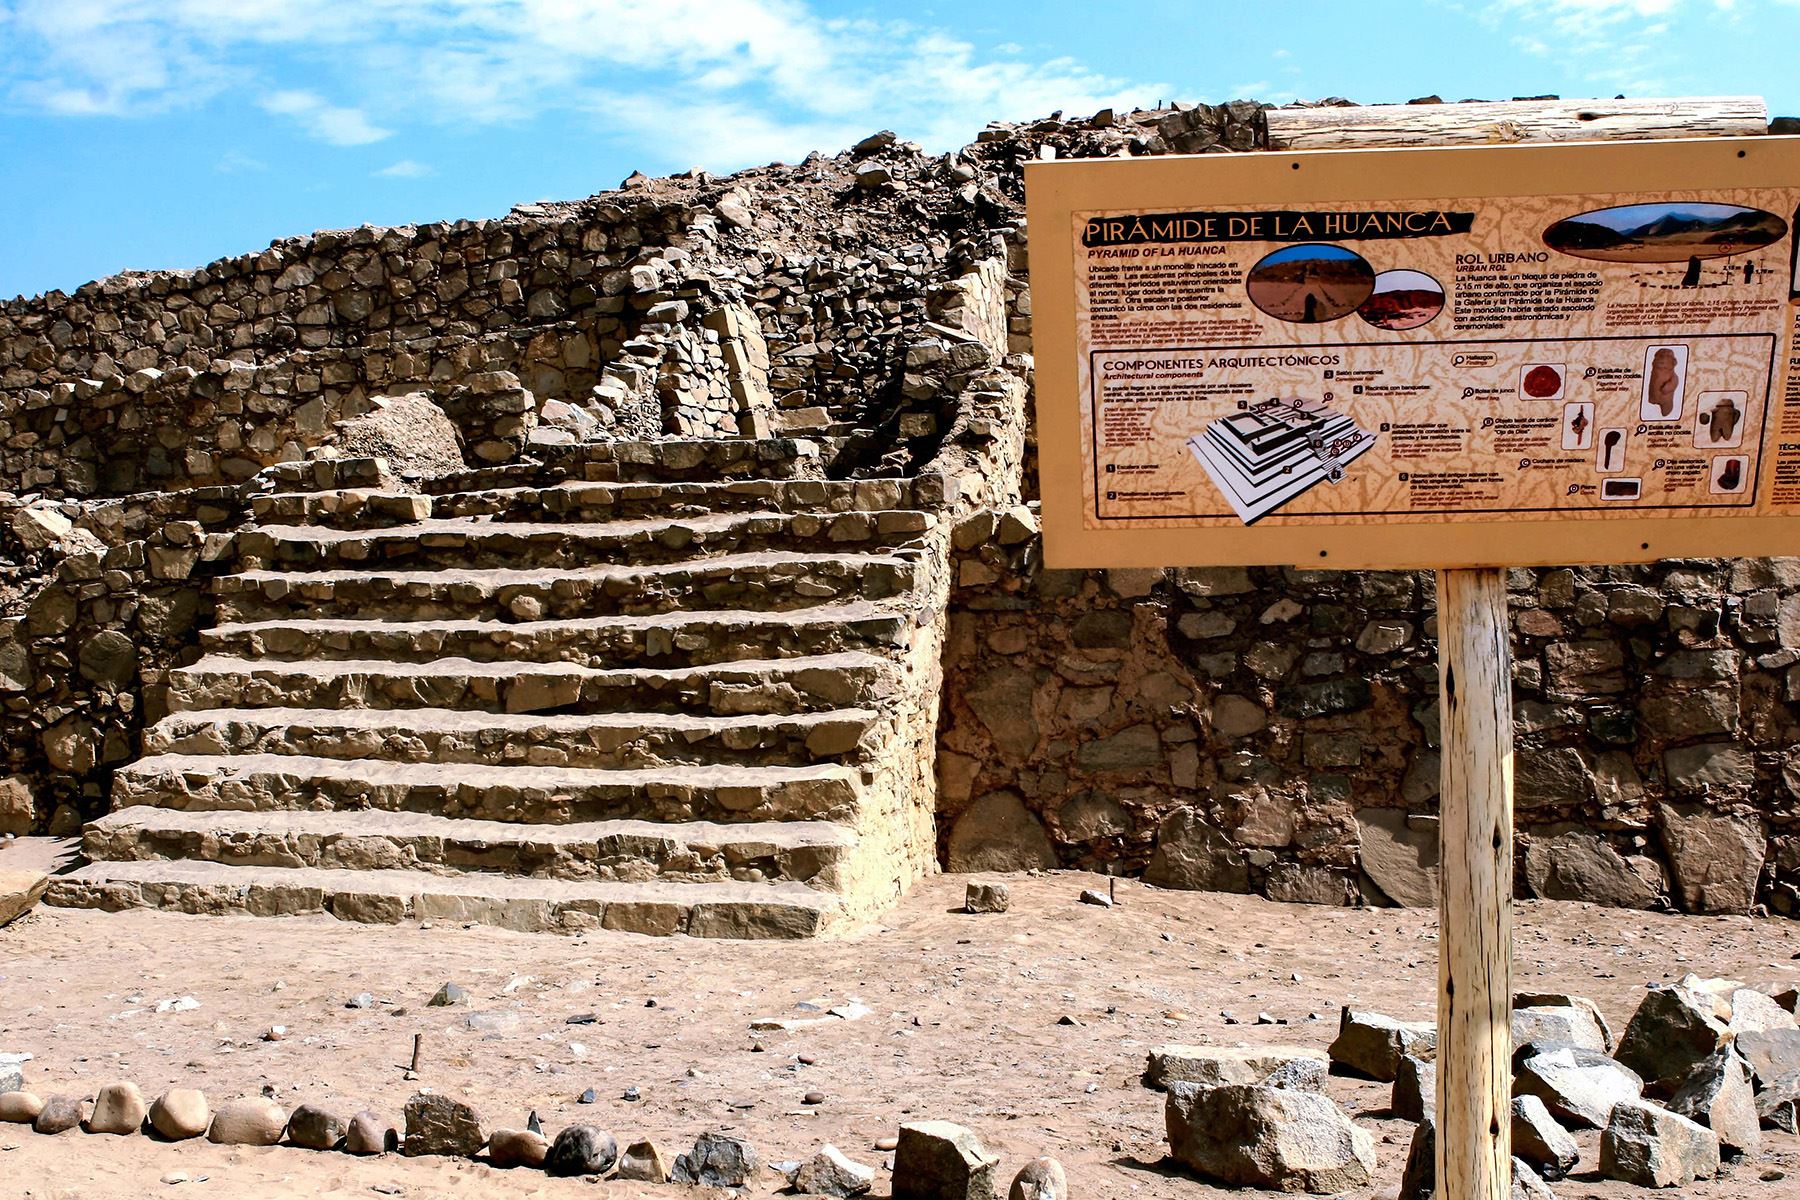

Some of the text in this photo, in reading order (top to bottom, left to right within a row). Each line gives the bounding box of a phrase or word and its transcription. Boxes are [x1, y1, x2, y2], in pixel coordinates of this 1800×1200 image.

[1086, 212, 1452, 242] PIRÁMIDE DE LA HUANCA
[1088, 246, 1226, 258] PYRAMID OF LA HUANCA
[1455, 252, 1549, 264] ROL URBANO
[1561, 272, 1585, 280] piedra
[1529, 280, 1563, 289] organiza
[1573, 280, 1603, 288] espacio
[1483, 289, 1529, 297] conformado
[1103, 355, 1340, 370] COMPONENTES ARQUITECTÓNICOS
